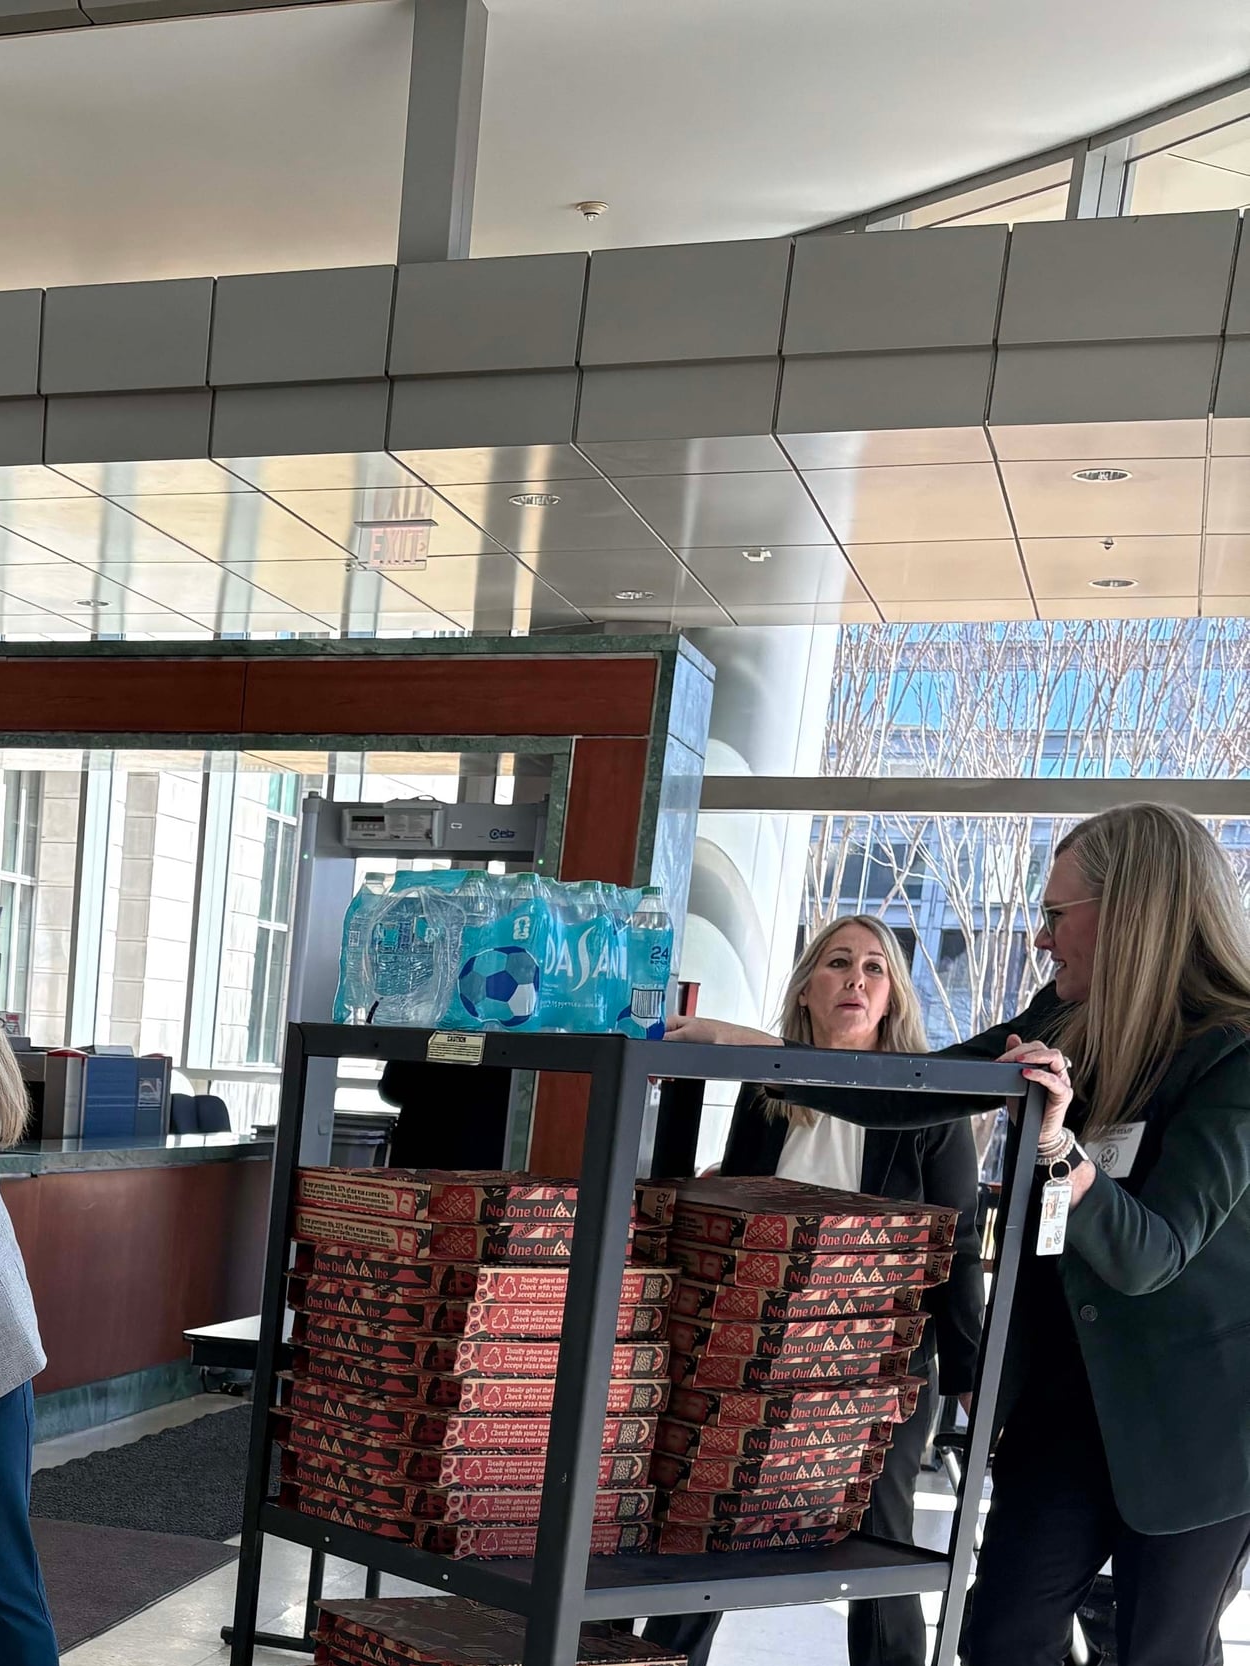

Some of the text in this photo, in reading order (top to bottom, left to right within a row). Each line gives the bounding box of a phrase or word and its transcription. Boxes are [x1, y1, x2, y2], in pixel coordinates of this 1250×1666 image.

[370, 527, 424, 566] EXIT
[651, 946, 669, 960] 24
[486, 1204, 555, 1218] No One Out
[798, 1232, 909, 1246] No One Out the
[488, 1243, 555, 1256] No One Out
[375, 1268, 388, 1279] the
[789, 1270, 902, 1285] No One Out the
[767, 1301, 875, 1318] No One Out the
[762, 1338, 872, 1354] No One Out the
[750, 1364, 859, 1381] No One Out the
[770, 1403, 875, 1419] No One Out the
[748, 1432, 852, 1450] No One Out the
[738, 1464, 841, 1484] No One Out the
[719, 1494, 825, 1513] No One Out the
